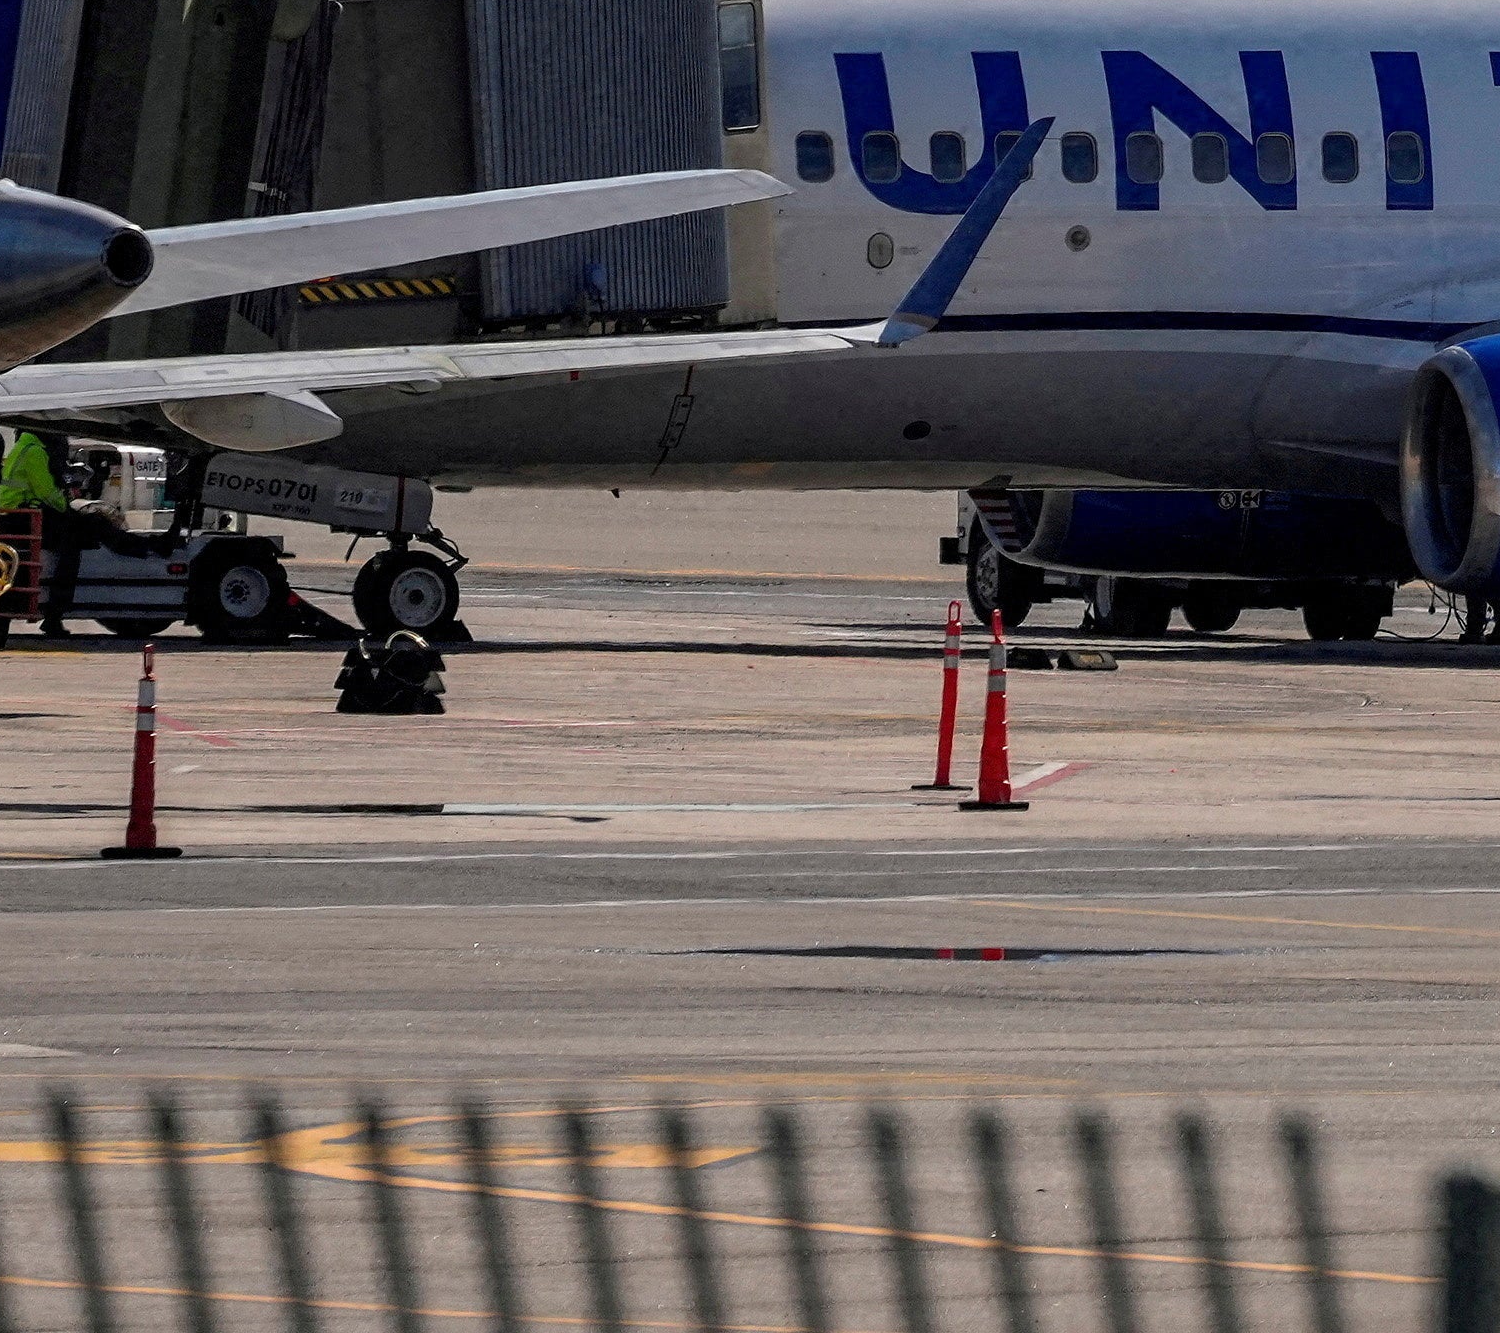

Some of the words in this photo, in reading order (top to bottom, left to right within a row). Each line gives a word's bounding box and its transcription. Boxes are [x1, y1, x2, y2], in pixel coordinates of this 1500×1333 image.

[136, 460, 159, 472] GATE
[207, 474, 264, 494] ETOPS
[269, 479, 317, 502] 0701
